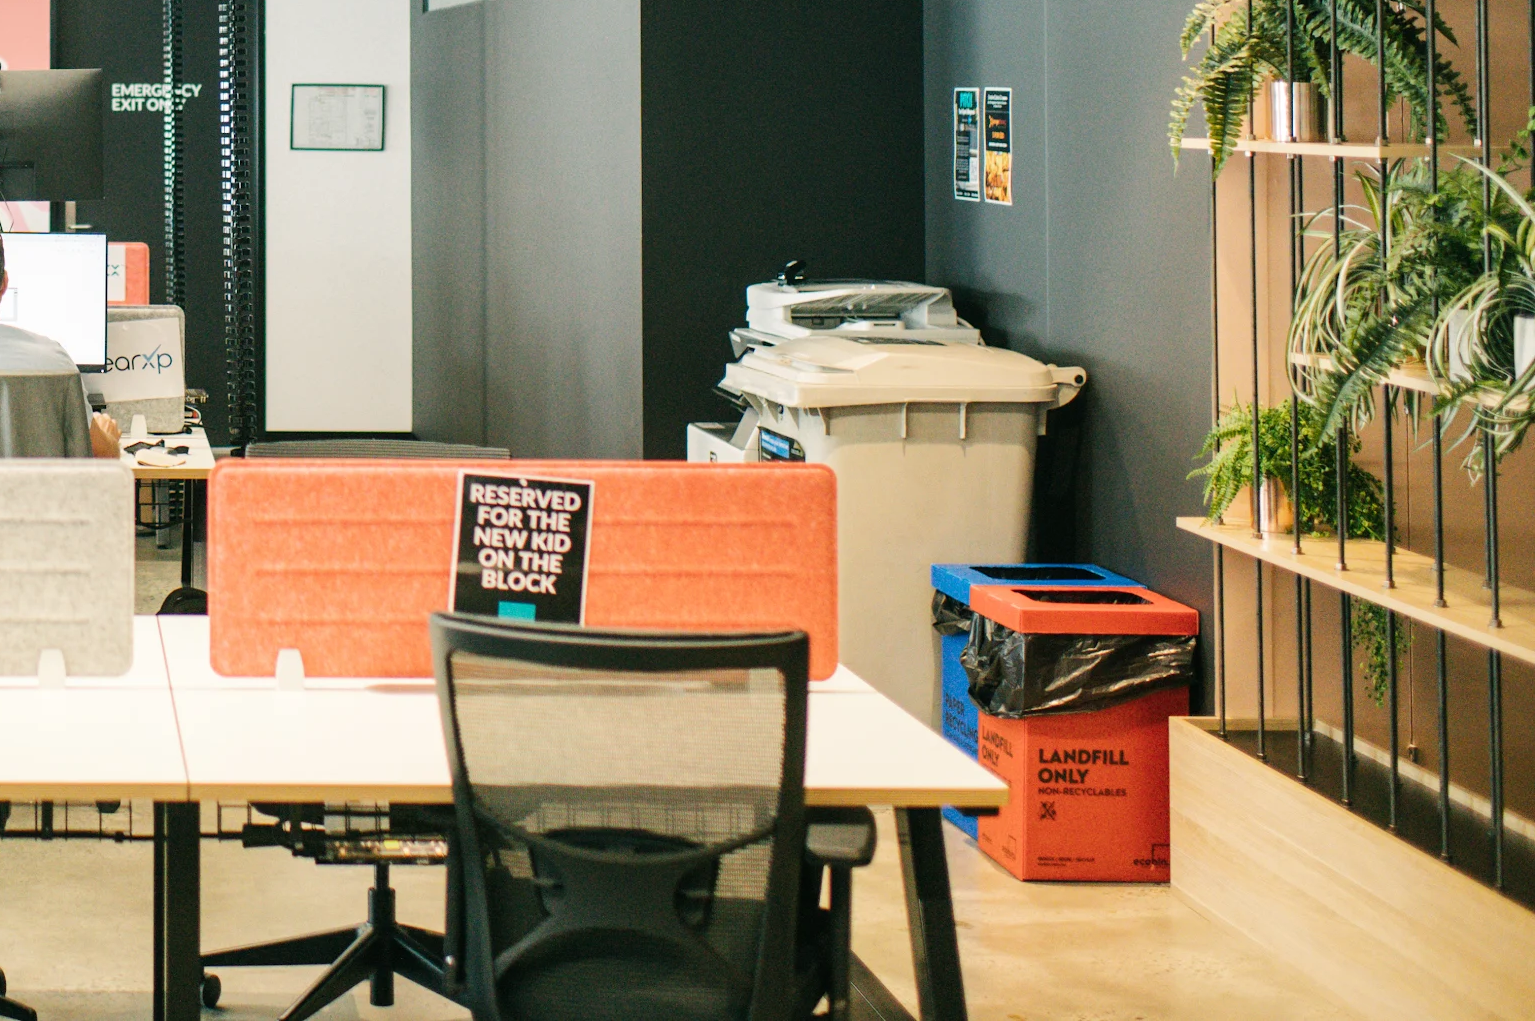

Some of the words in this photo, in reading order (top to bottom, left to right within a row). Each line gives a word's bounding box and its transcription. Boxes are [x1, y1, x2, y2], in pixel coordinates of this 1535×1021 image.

[111, 83, 202, 97] EMERGCY
[111, 98, 145, 112] EXIT
[146, 98, 186, 112] ON
[469, 483, 582, 511] RESERVED
[477, 505, 523, 528] FOR
[526, 509, 572, 532] THE
[473, 526, 528, 549] NEW
[530, 532, 572, 553] KID
[478, 548, 515, 570] ON
[518, 551, 563, 574] THE
[481, 568, 557, 595] BLOCK
[982, 725, 1014, 758] LANDFILL
[981, 745, 1000, 767] ONLY
[1038, 748, 1129, 766] LANDFILL
[1037, 768, 1089, 784] ONLY
[1038, 787, 1127, 797] NON-RECYCLABLES
